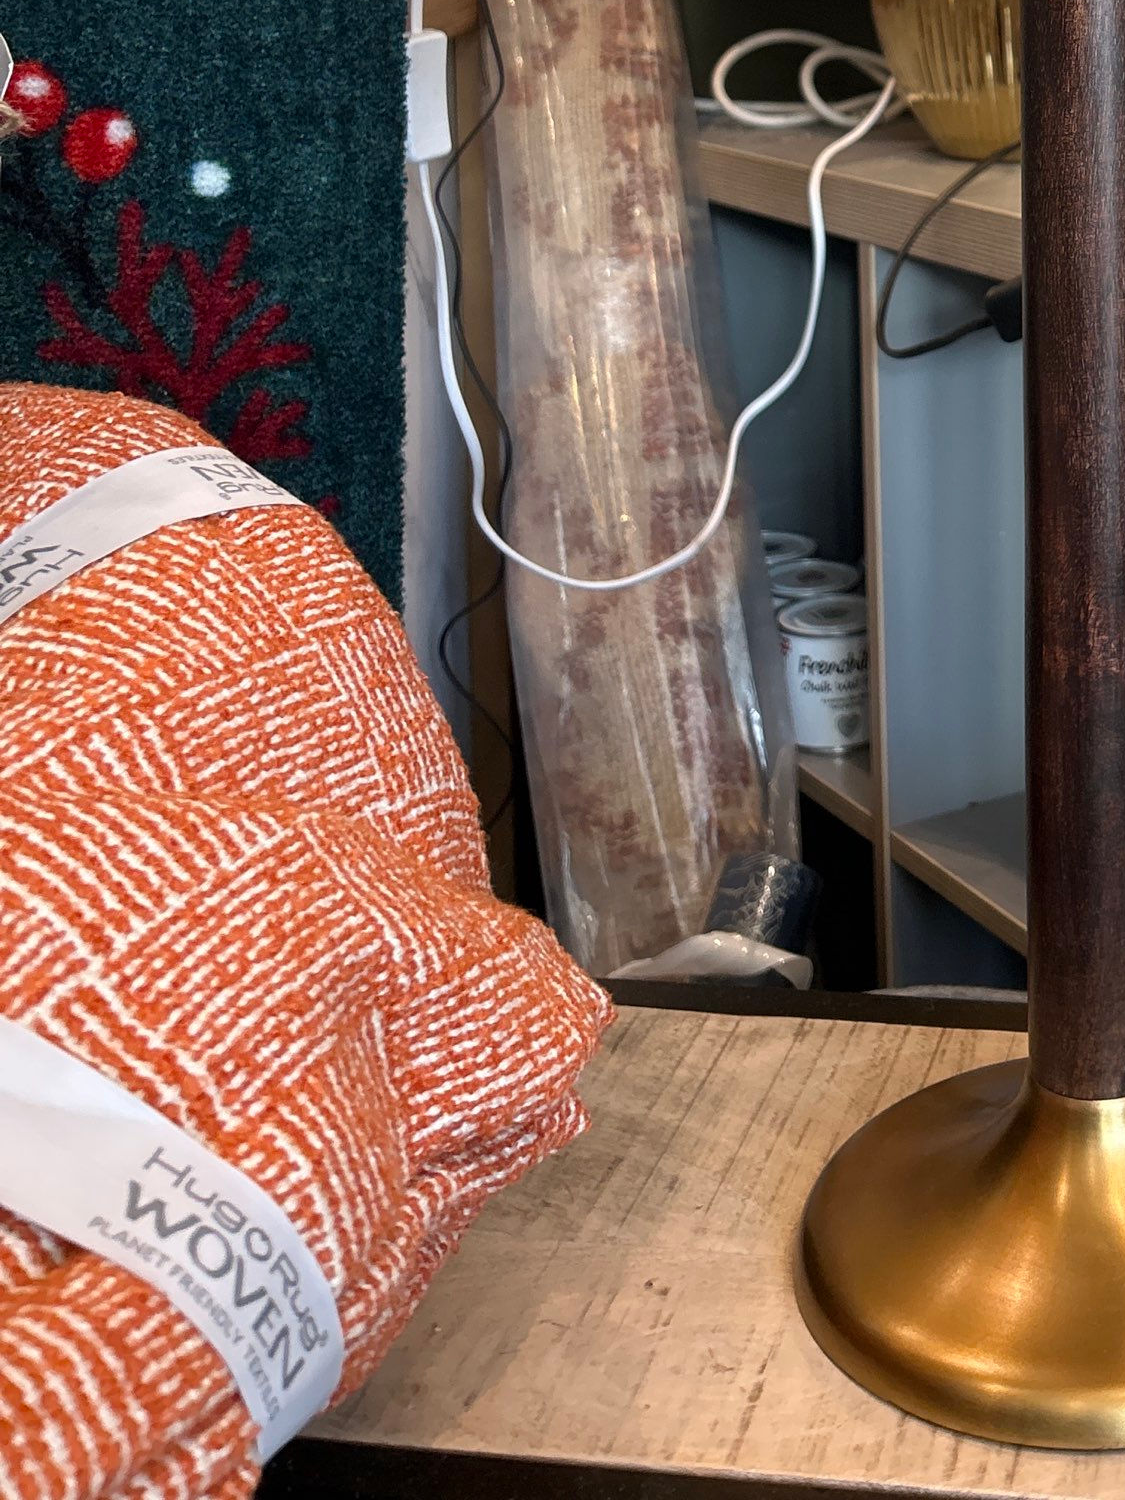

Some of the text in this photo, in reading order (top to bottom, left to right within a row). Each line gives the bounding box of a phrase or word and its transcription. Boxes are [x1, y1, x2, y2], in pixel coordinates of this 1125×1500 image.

[87, 1215, 283, 1421] PLANET FRIENDLY TEXTILES
[124, 1179, 309, 1391] WOVEN
